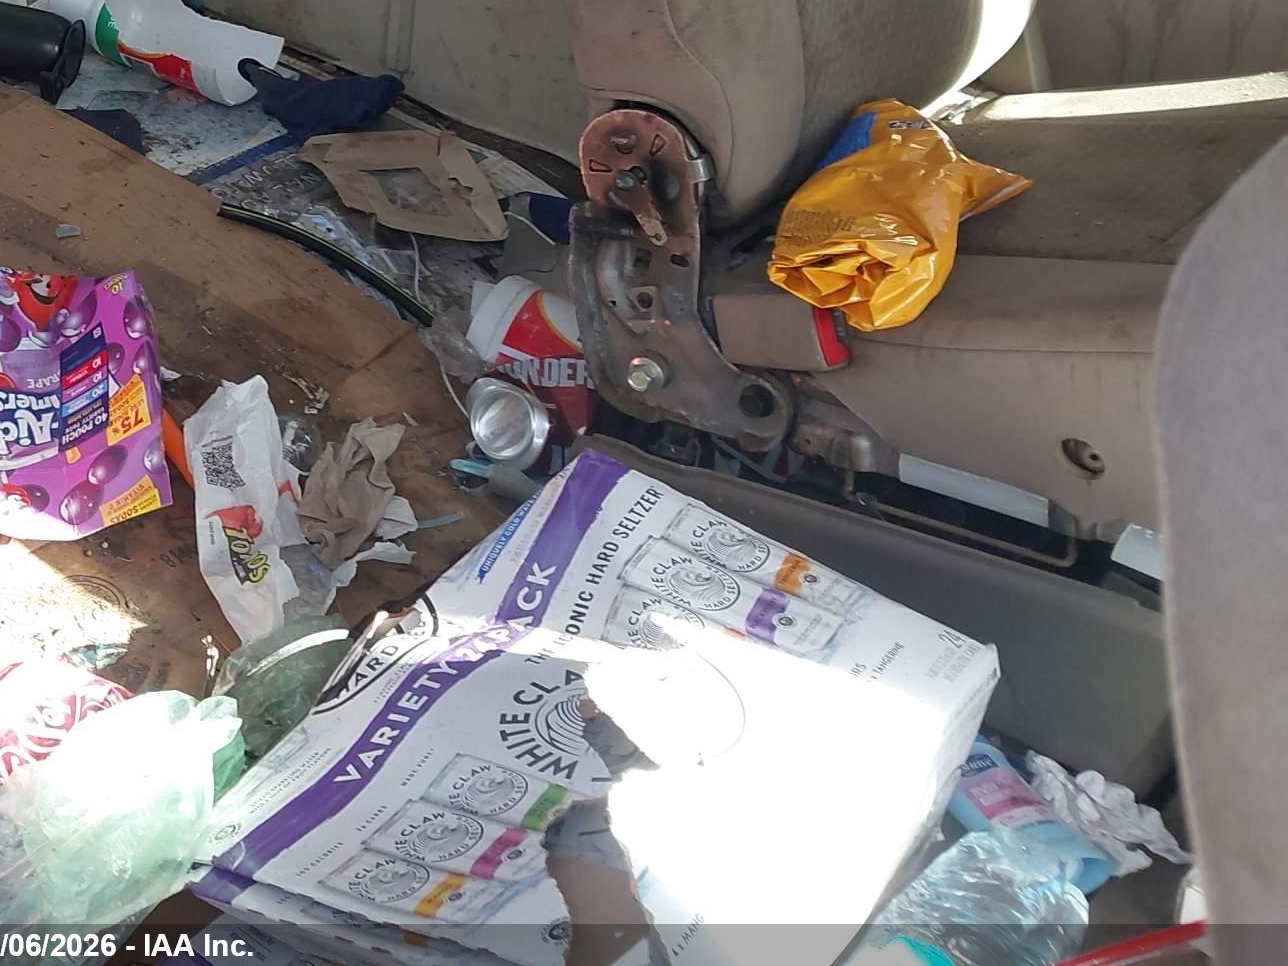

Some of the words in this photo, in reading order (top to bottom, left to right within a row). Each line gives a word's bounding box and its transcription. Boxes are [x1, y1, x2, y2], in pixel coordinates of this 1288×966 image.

[585, 541, 620, 585] HARD
[653, 555, 693, 575] CLAW
[938, 629, 967, 650] 24
[333, 659, 459, 784] VARIETY
[499, 712, 579, 780] WHITE
[452, 764, 492, 794] CLAW
[400, 811, 446, 838] CLAW
[354, 857, 397, 882] CLAW
[681, 913, 706, 945] MANG
